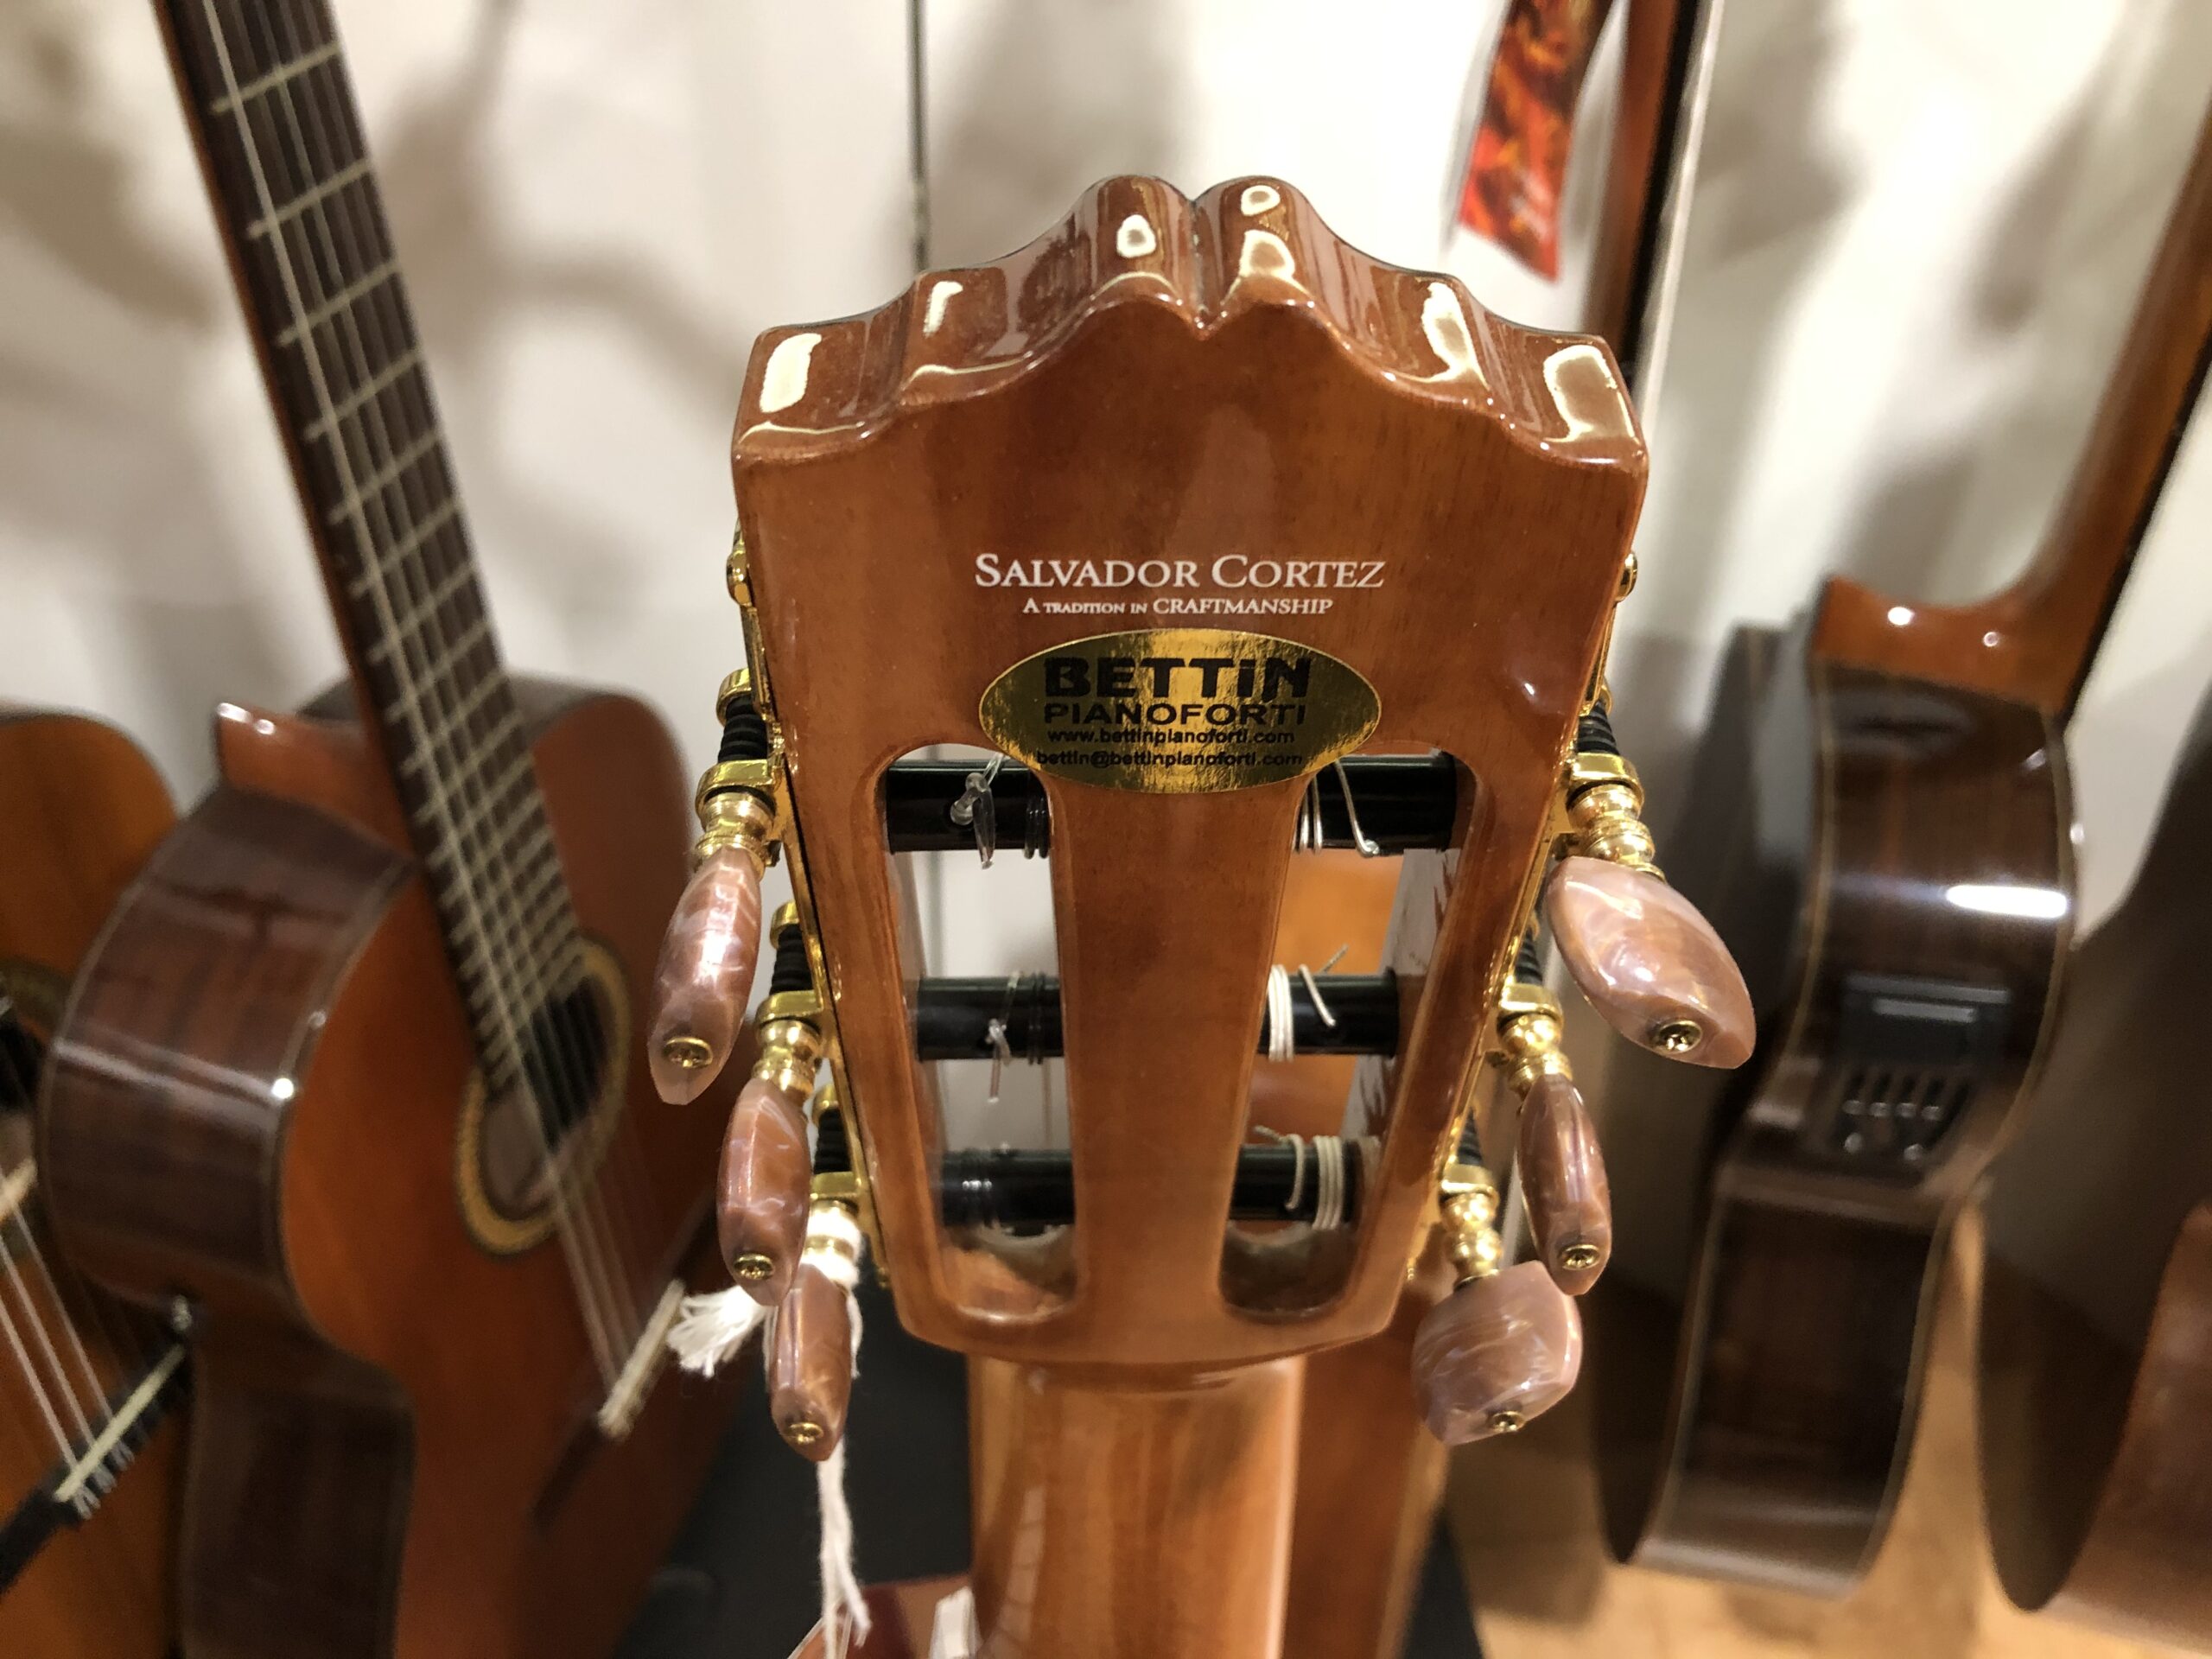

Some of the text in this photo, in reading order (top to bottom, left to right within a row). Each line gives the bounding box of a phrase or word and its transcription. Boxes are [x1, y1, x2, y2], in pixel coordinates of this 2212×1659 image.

[975, 553, 1386, 588] SALVADOR CORTEZ
[1022, 597, 1333, 614] A TRADITION IN CRAFTMANSHIP
[1044, 702, 1306, 726] PIANOFORTI
[1047, 728, 1294, 746] www.bettinpianoforti.com
